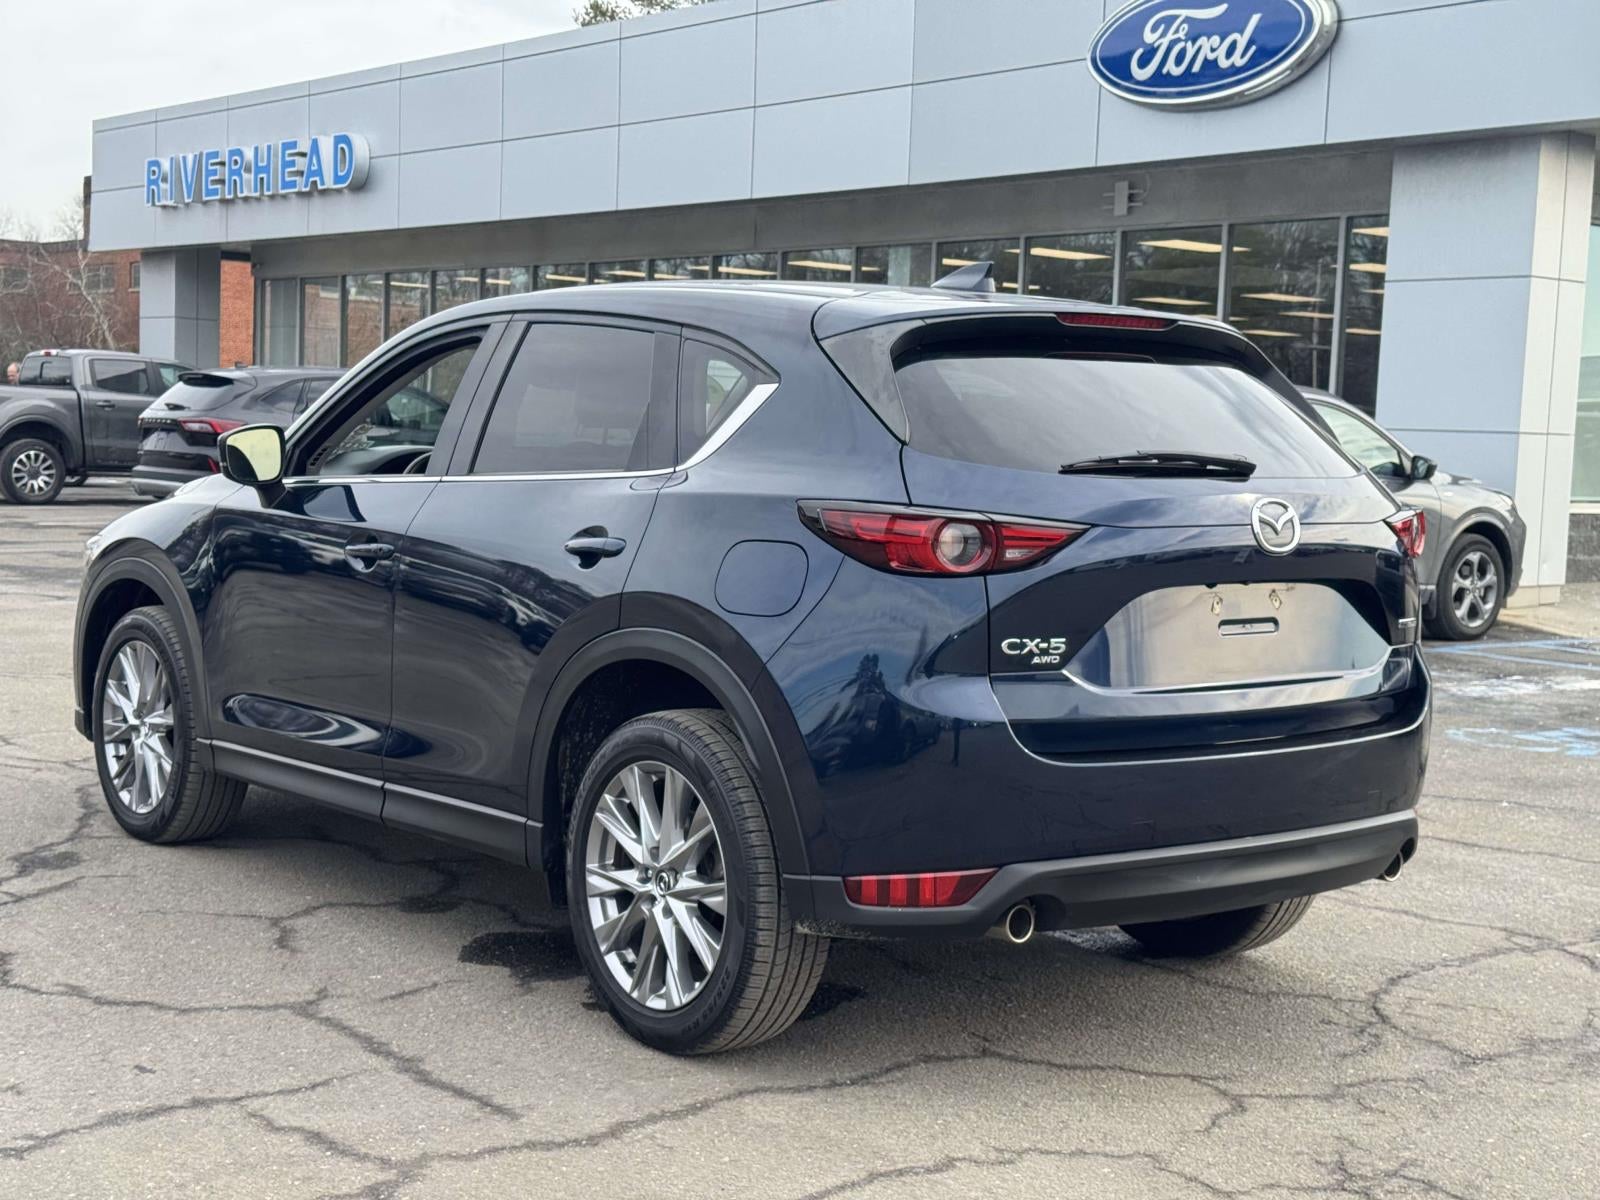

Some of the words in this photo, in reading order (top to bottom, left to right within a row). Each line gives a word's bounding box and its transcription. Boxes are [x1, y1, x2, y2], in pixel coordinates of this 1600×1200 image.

[1130, 3, 1263, 81] Ford
[144, 132, 356, 207] RIVERHEAD
[1001, 637, 1067, 655] CX-5
[1031, 655, 1060, 665] AWD
